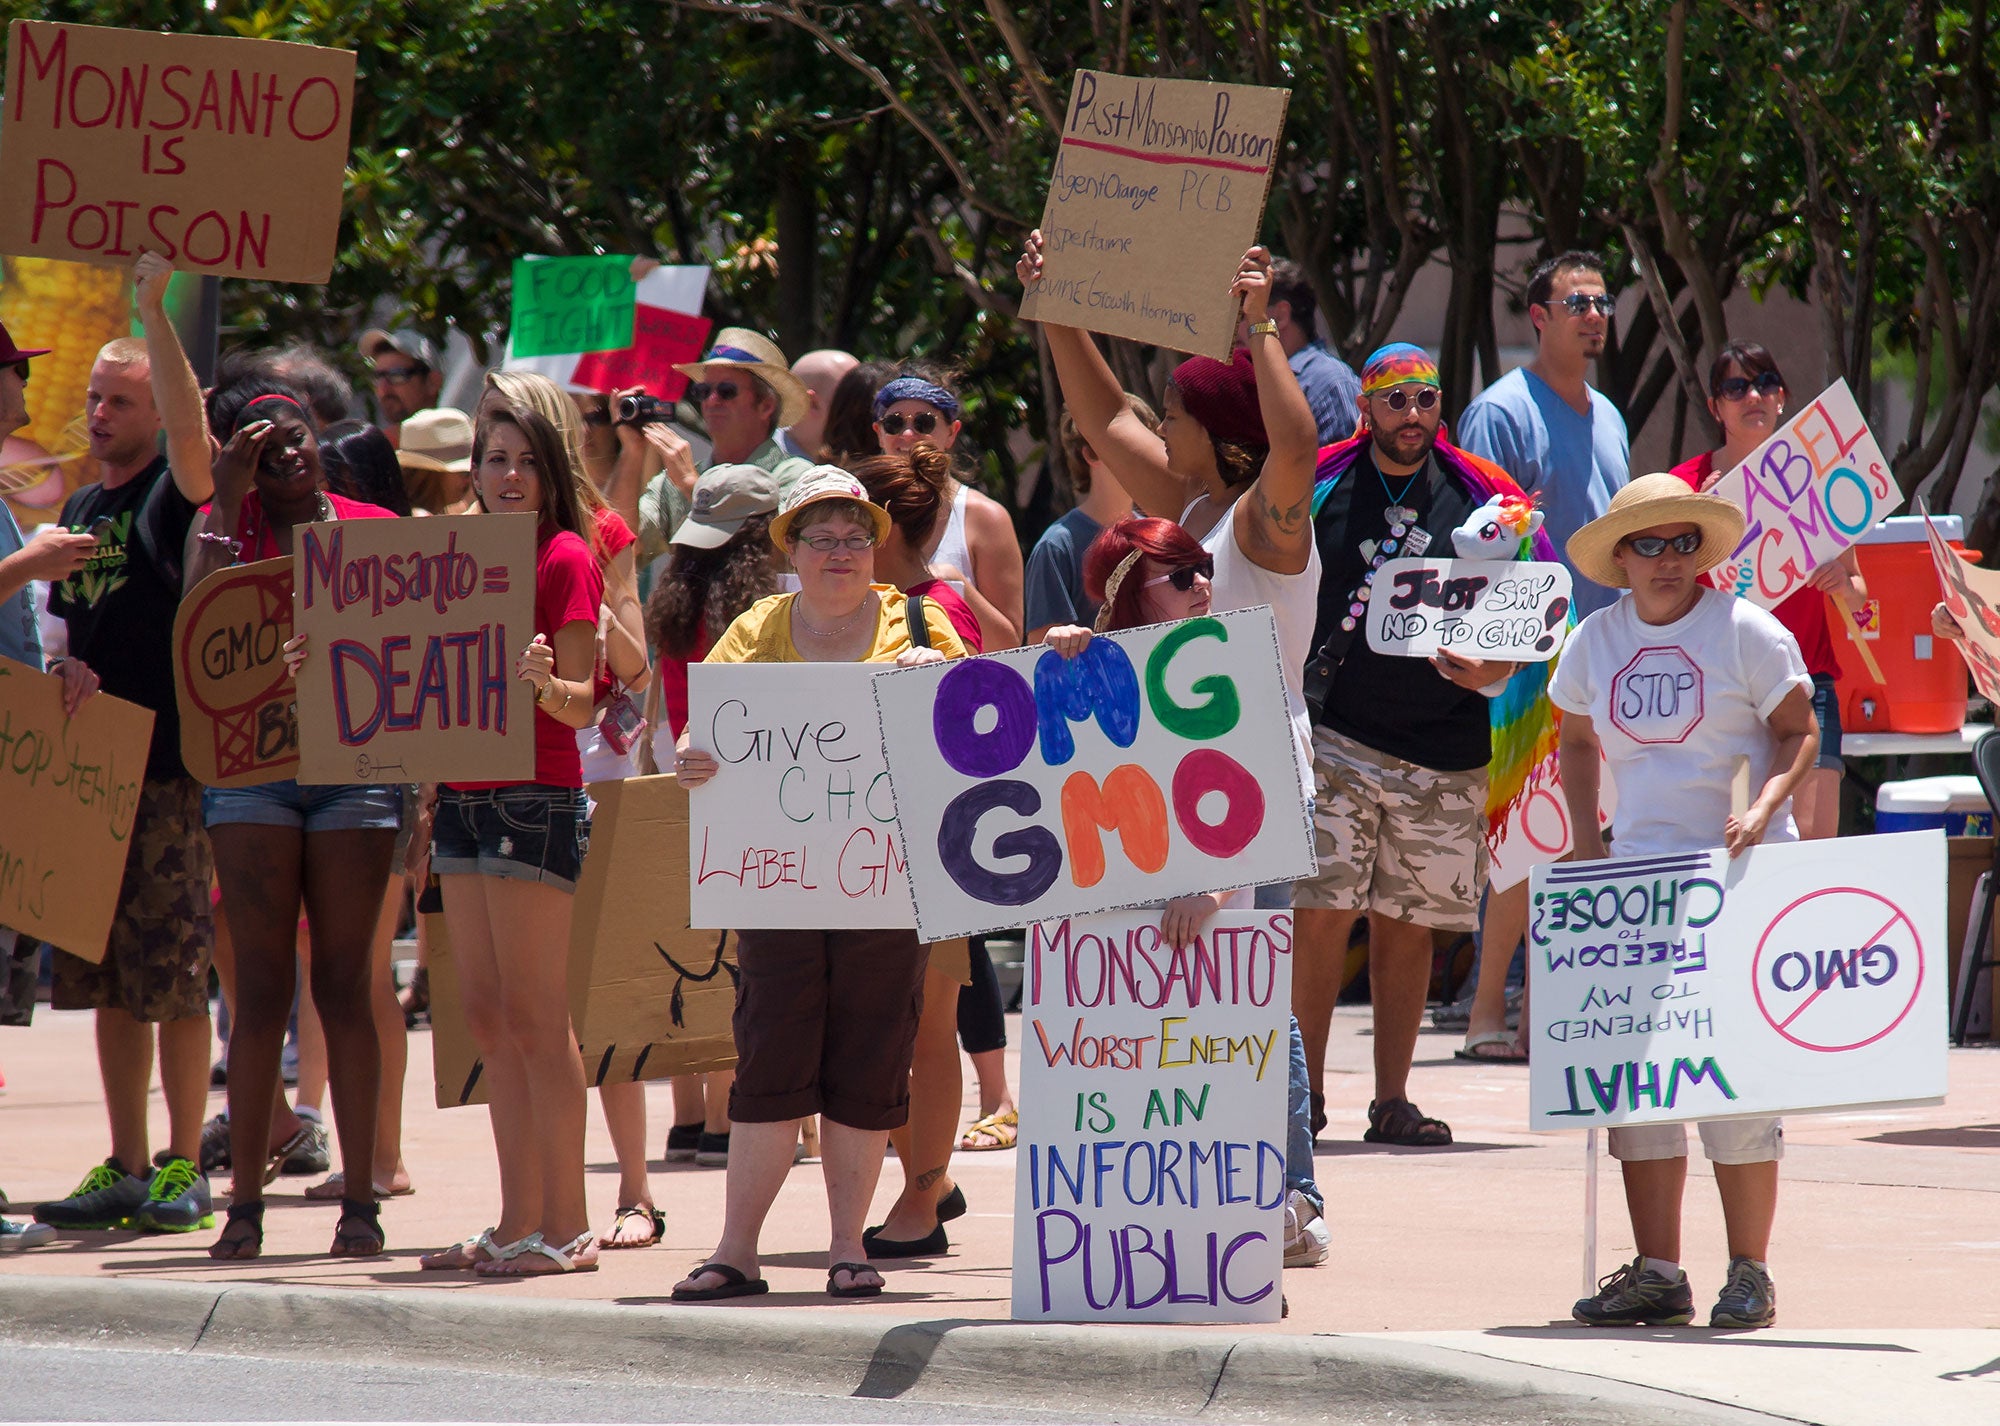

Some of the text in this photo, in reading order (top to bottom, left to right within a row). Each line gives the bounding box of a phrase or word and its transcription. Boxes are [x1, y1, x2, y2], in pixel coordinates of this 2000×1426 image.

[143, 135, 186, 175] IS
[1208, 91, 1274, 165] Poison
[31, 158, 270, 270] POISON
[532, 262, 632, 303] FOOD
[1088, 270, 1135, 314] Growth
[517, 301, 632, 352] FIGHT
[302, 526, 479, 617] Monsanto
[1485, 574, 1555, 611] SAY
[201, 617, 280, 681] GMO
[1382, 612, 1427, 642] NO
[1433, 617, 1473, 646] TO
[328, 621, 508, 747] DEATH
[933, 616, 1241, 778] OMG
[1621, 672, 1695, 719] STOP
[698, 826, 817, 889] LABEL
[937, 748, 1265, 907] GMO
[1531, 877, 1725, 946] CHOOSE?
[1546, 932, 1707, 974] FREEDOM
[1771, 944, 1898, 992] GMO
[1548, 1006, 1713, 1042] HAPPENED
[1580, 981, 1700, 1012] TO MY
[1031, 1016, 1278, 1082] WORST ENEMY
[1074, 1083, 1211, 1134] IS AN
[1546, 1056, 1738, 1116] WHAT
[1029, 1139, 1287, 1211] INFORMED
[1035, 1208, 1275, 1313] PUBLIC
